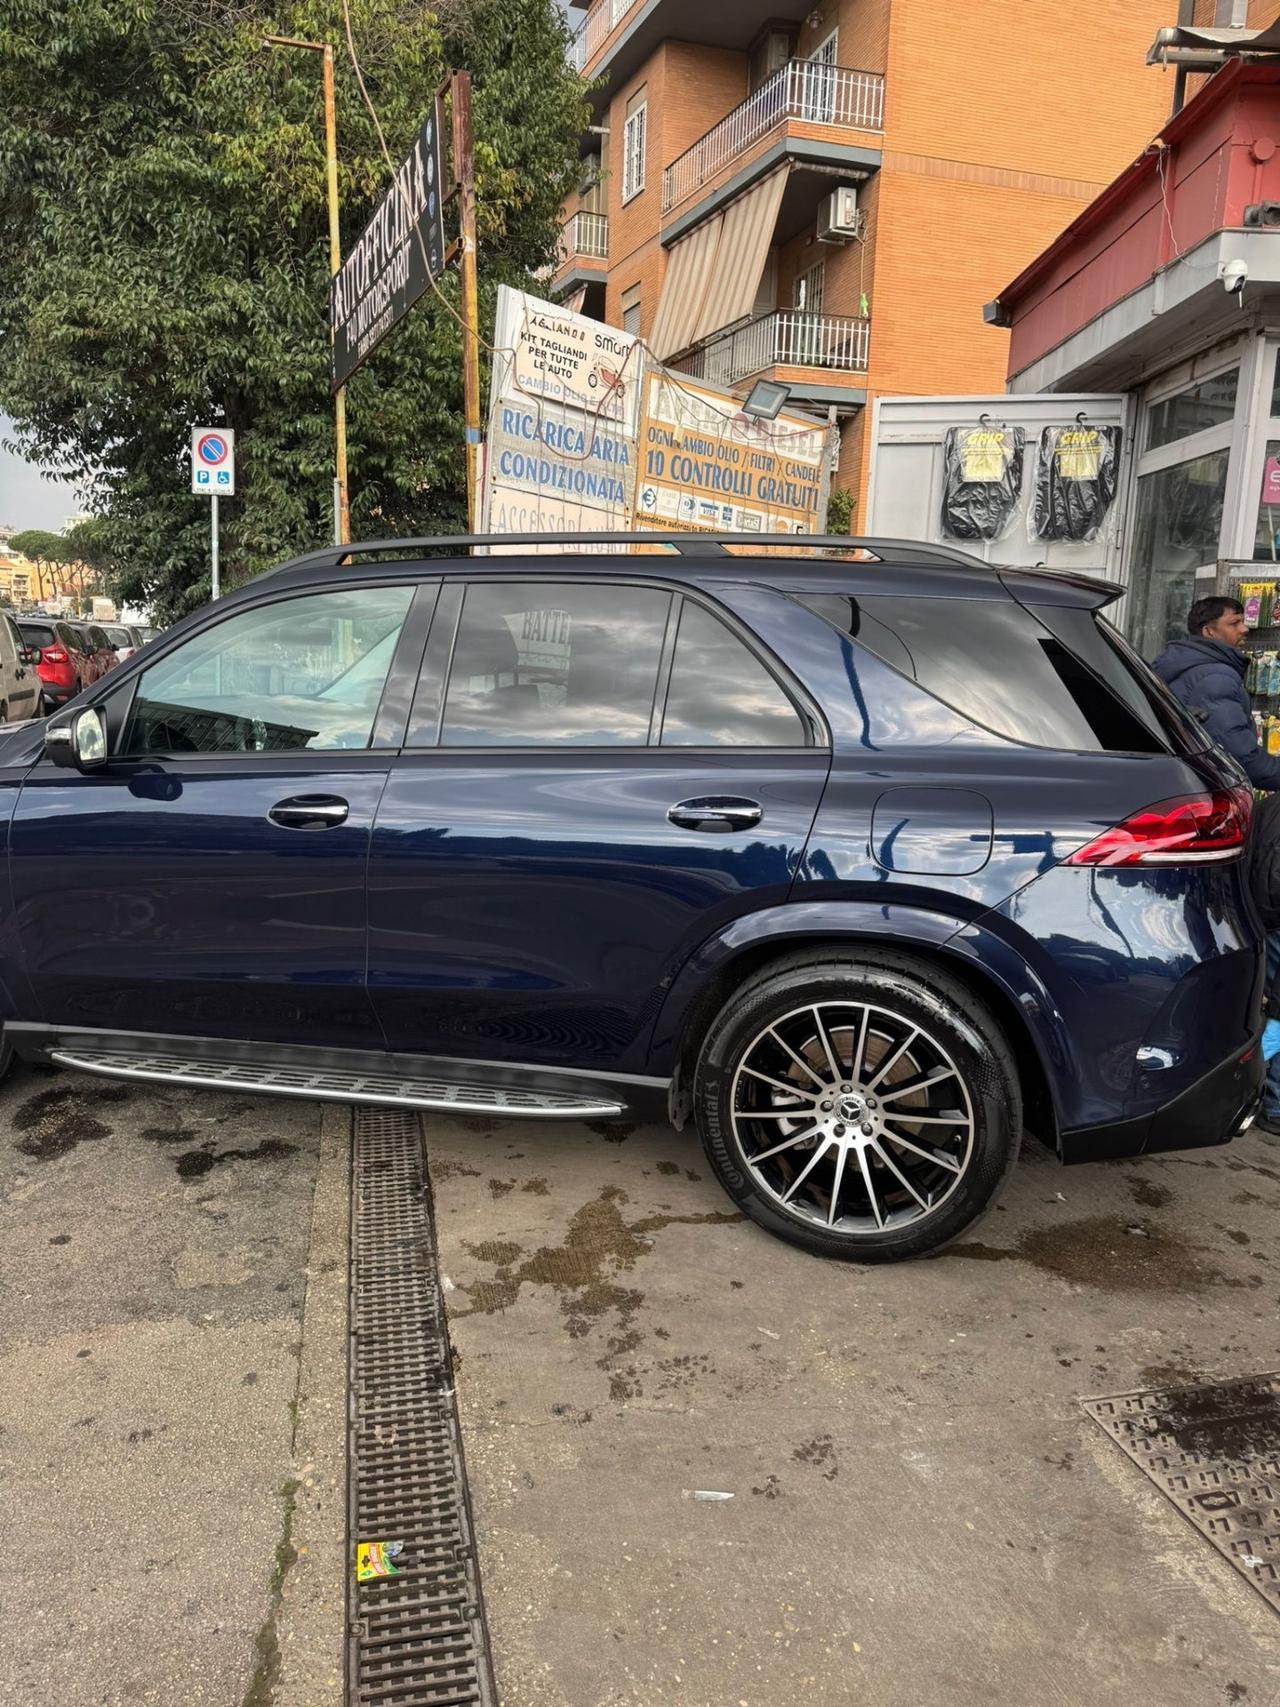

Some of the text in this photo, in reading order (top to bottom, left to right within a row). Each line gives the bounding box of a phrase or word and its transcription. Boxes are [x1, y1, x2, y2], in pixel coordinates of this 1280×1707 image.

[334, 140, 428, 332] AUTOFFICINA
[357, 239, 412, 338] MOTORSPORT
[520, 331, 588, 361] KIT TAGLIANDI
[528, 346, 580, 370] PER TUTTE
[595, 334, 631, 358] smart
[518, 374, 561, 395] CAMBIO
[533, 359, 573, 379] LE AUTO
[502, 408, 630, 466] RICARICA ARIA
[648, 427, 674, 448] OGNI
[676, 433, 714, 457] AMBIO
[717, 444, 740, 464] OLIO
[750, 453, 775, 473] FILTRI
[785, 461, 822, 484] CANDELE
[968, 432, 1004, 445] GRIP
[1061, 431, 1099, 445] GRIP
[500, 450, 625, 503] CONDIZIONATA
[647, 450, 819, 511] 10 CONTROLLI GRATUITI
[703, 1093, 745, 1189] Continental
